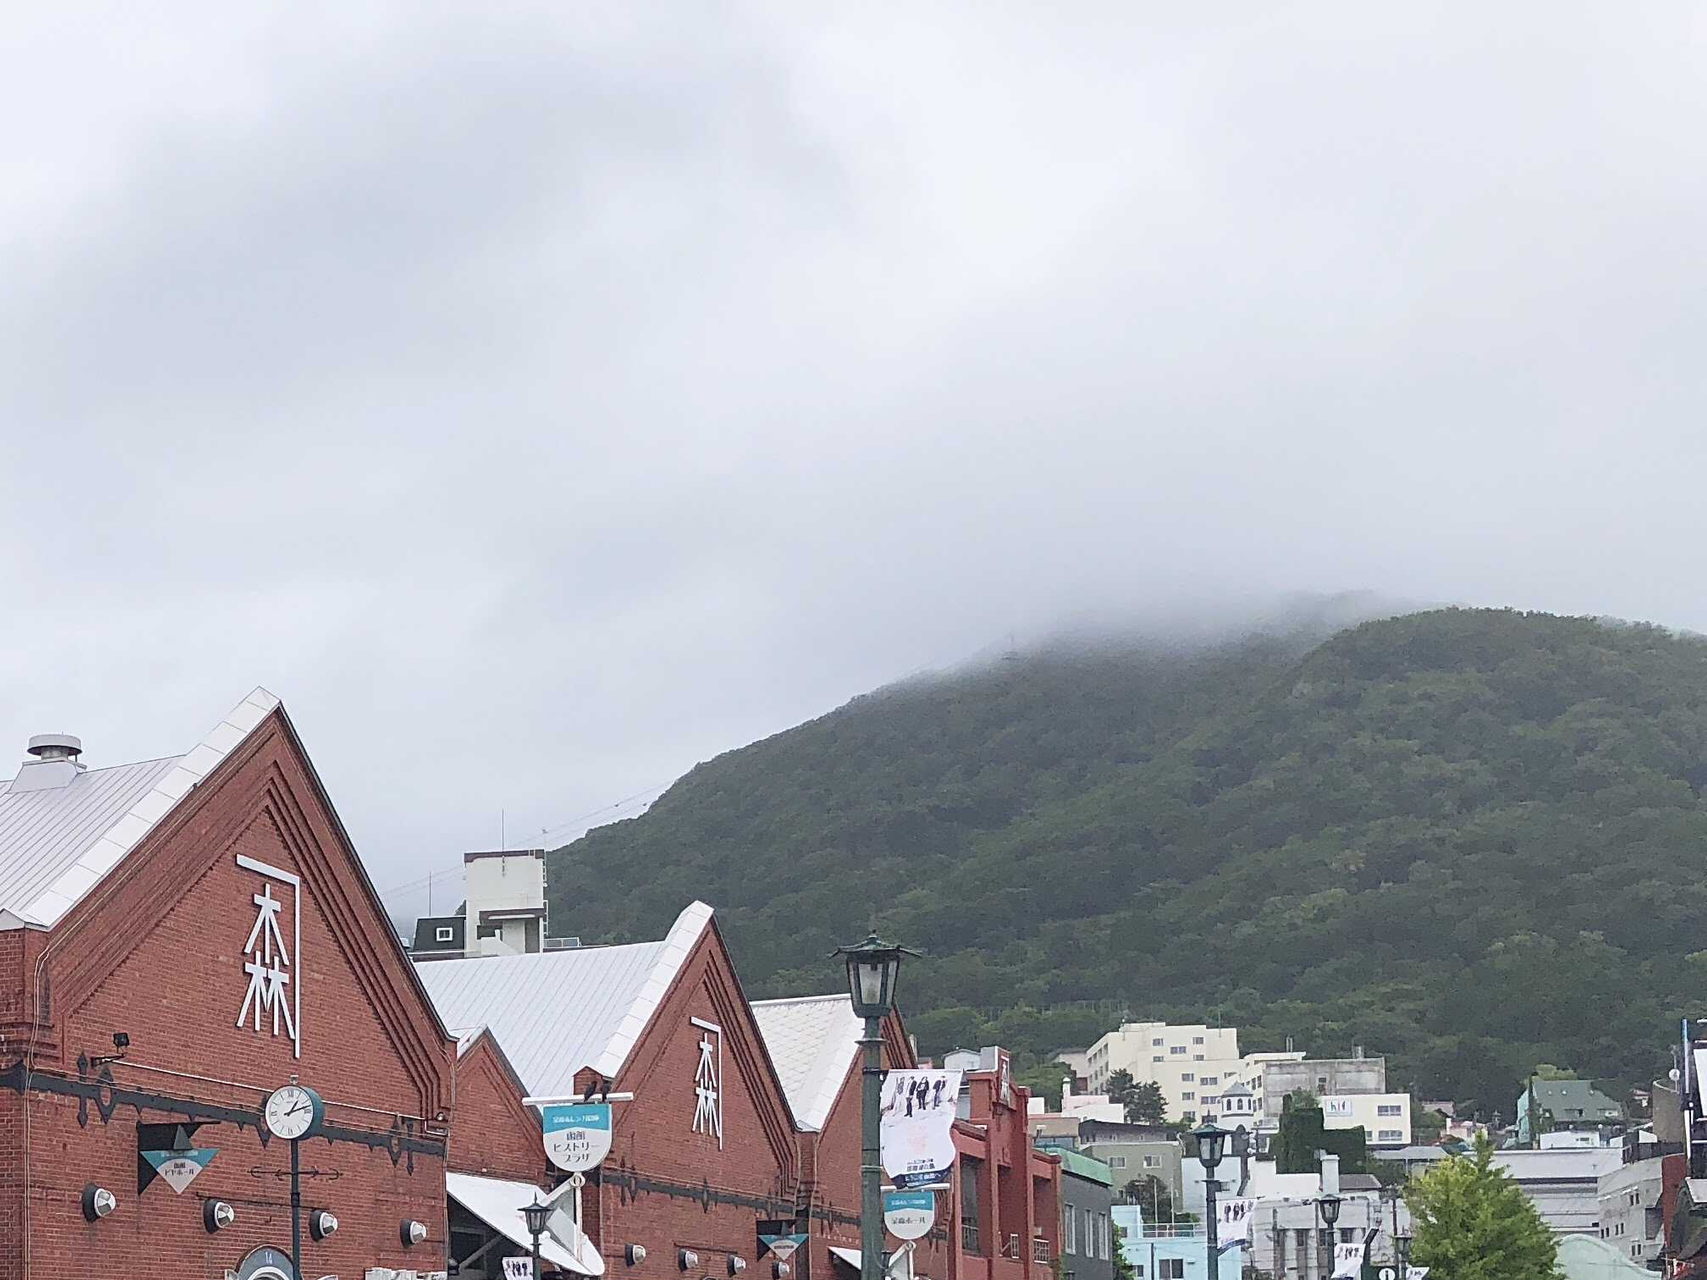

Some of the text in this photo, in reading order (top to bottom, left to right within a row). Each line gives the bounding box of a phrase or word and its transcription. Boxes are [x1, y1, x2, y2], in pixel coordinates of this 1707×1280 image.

[553, 1142, 600, 1152] ヒストリー
